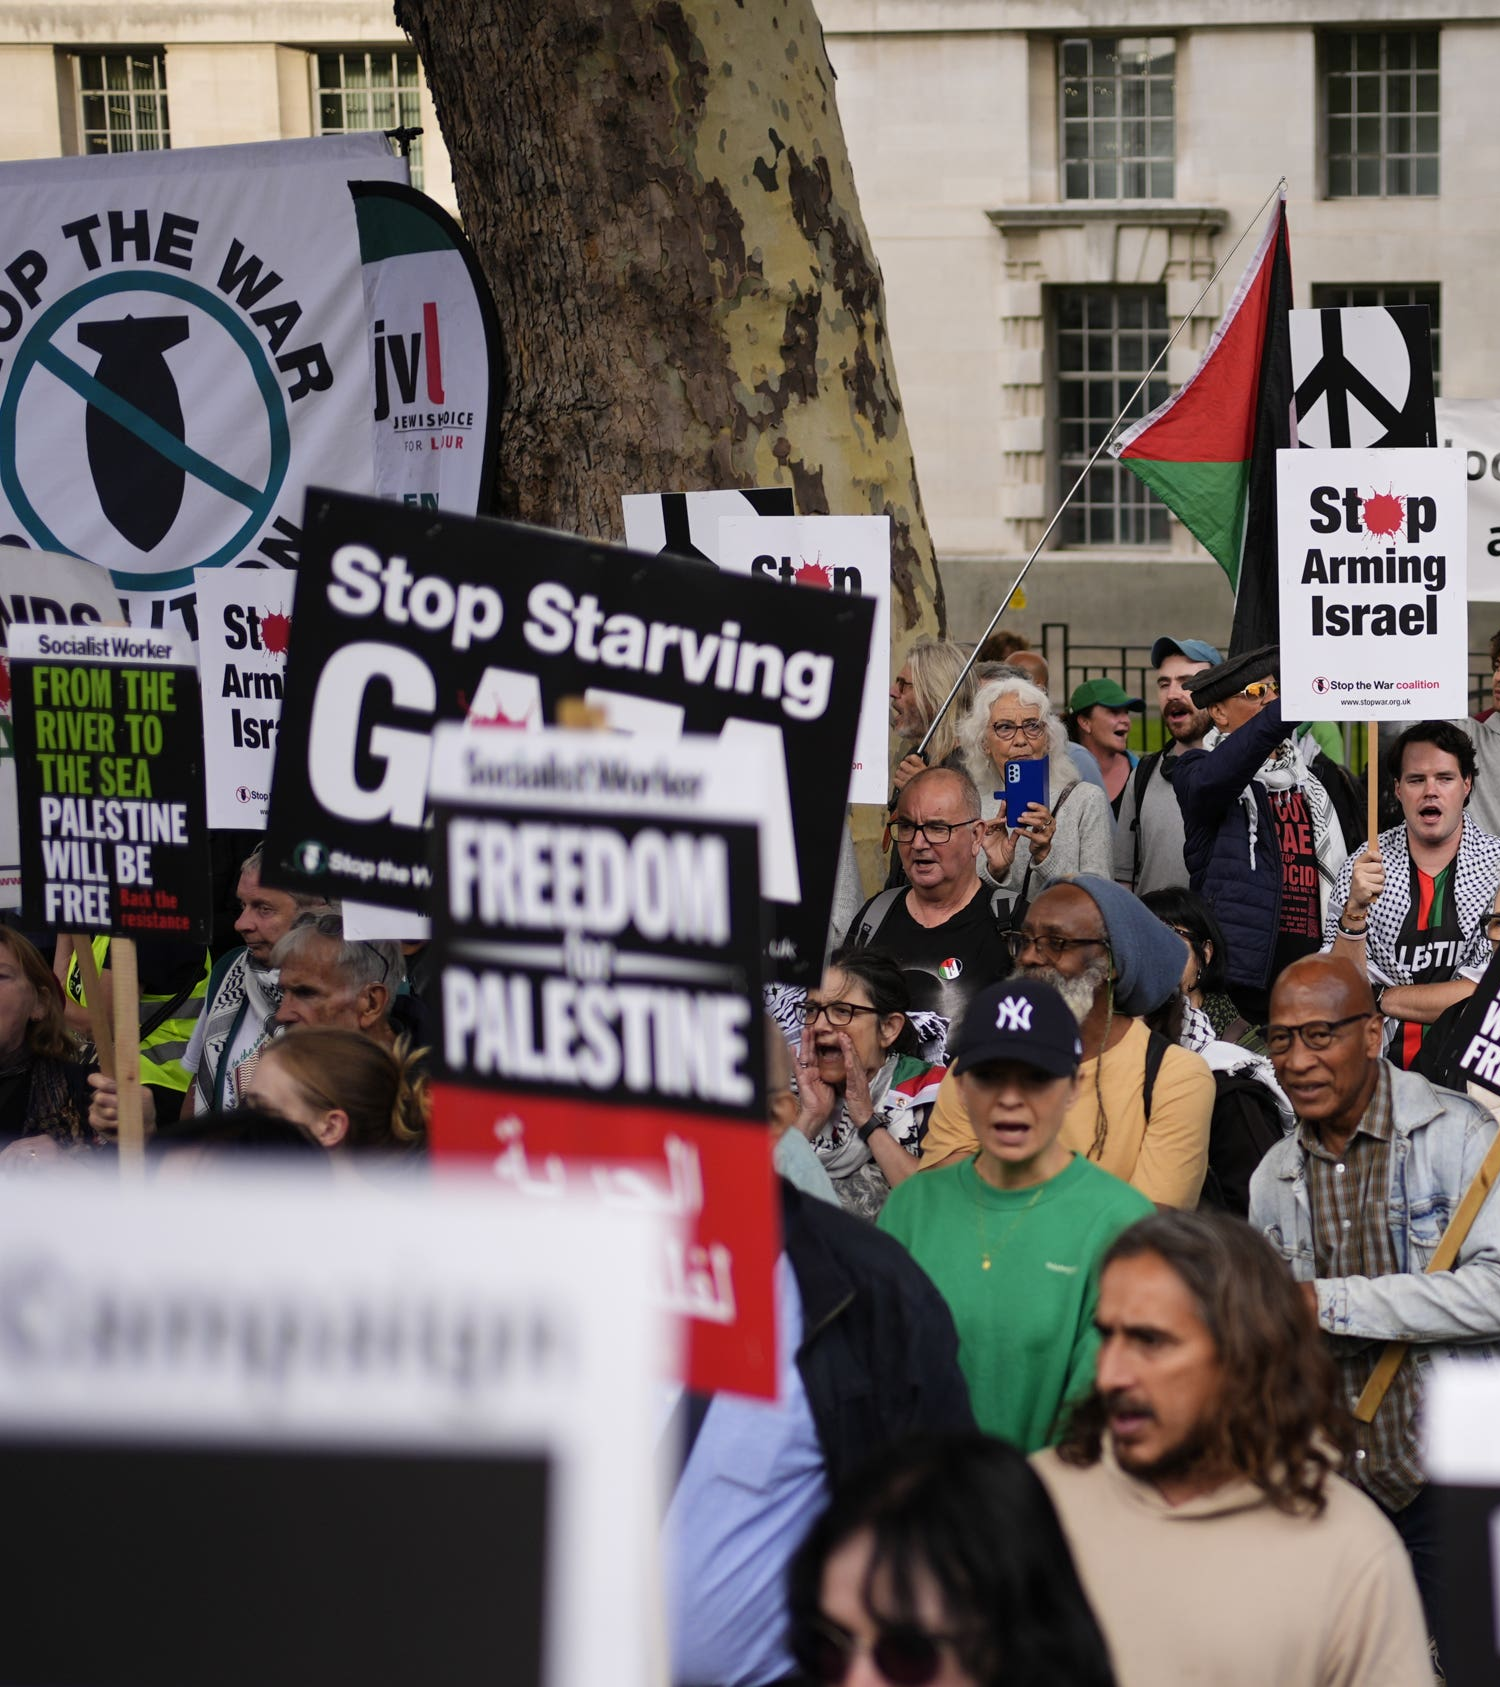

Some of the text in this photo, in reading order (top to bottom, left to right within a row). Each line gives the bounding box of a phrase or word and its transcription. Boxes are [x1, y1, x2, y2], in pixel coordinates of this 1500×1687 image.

[61, 208, 200, 272] THE
[216, 236, 335, 403] WAR
[373, 301, 445, 422] jvl
[443, 410, 474, 427] OICE
[404, 440, 423, 453] FOR
[1301, 547, 1446, 592] Arming
[326, 542, 504, 651] Stop
[522, 581, 835, 722] Starving
[1312, 594, 1438, 636] Israel
[38, 633, 173, 659] Socialist Worker
[32, 666, 177, 712] FROM THE
[222, 663, 287, 700] Arm
[1330, 680, 1440, 692] Stop the War coalition
[1340, 698, 1412, 707] www.stopwar.org.uk
[34, 710, 116, 753] RIVER
[124, 714, 164, 755] TO
[231, 708, 280, 750] Isr
[36, 754, 152, 798] THE SEA
[251, 790, 269, 802] Stop
[39, 797, 189, 844] PALESTINE
[41, 840, 110, 882] WILL
[115, 845, 154, 885] BE
[447, 814, 731, 948] FREEDOM
[44, 883, 112, 925] FREE
[119, 888, 178, 910] Back the
[120, 912, 190, 931] resistance
[441, 963, 756, 1108] PALESTINE
